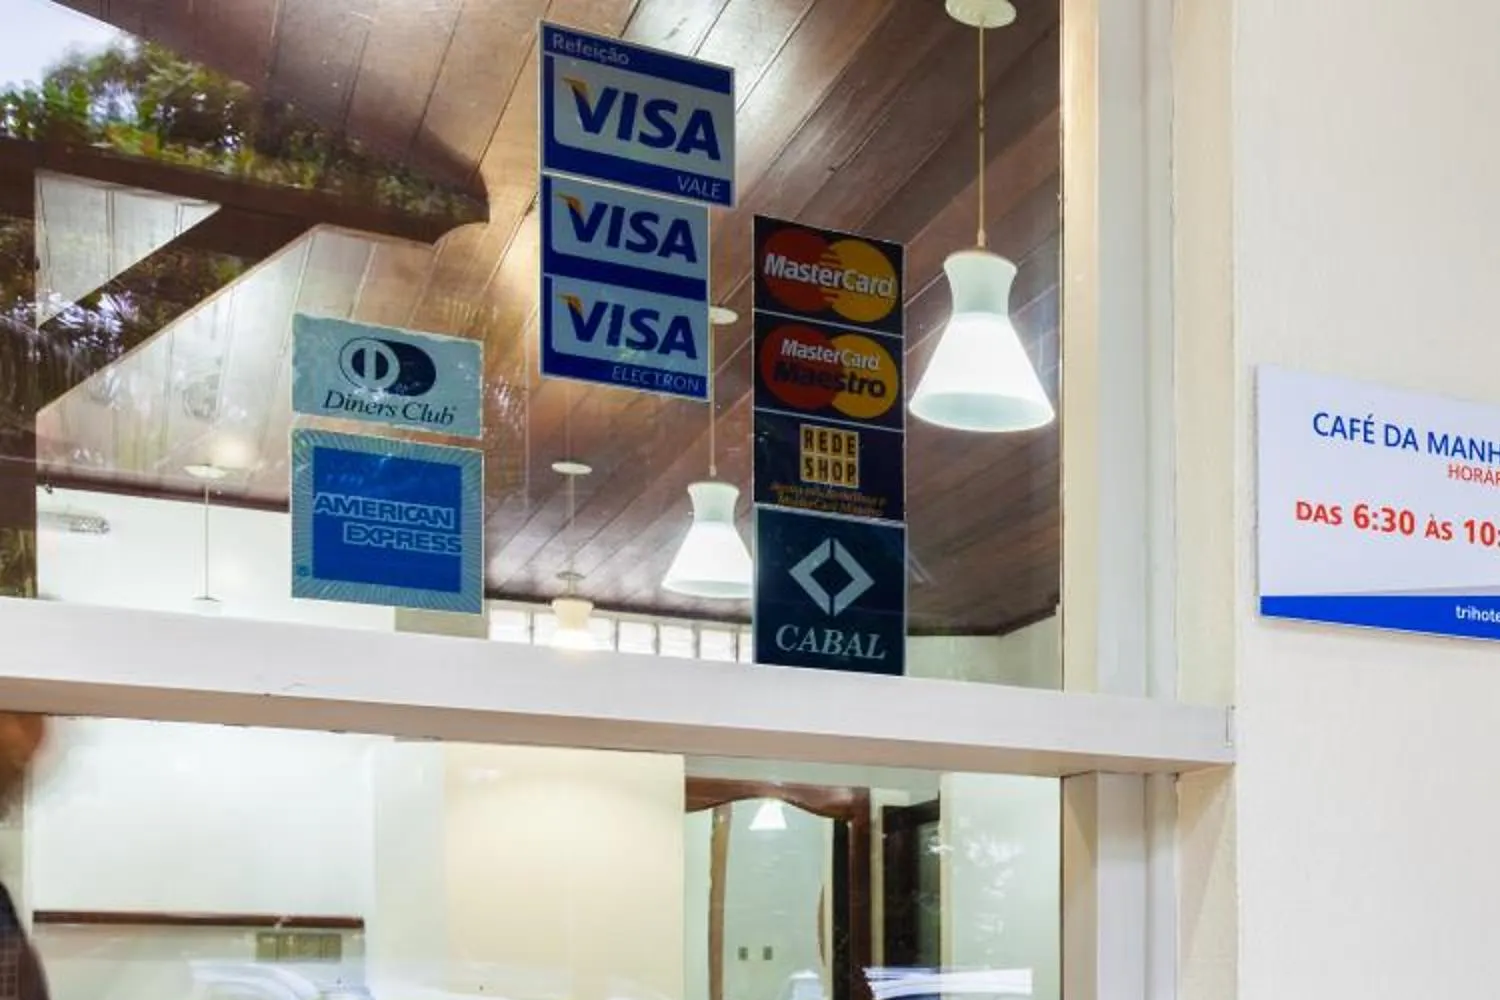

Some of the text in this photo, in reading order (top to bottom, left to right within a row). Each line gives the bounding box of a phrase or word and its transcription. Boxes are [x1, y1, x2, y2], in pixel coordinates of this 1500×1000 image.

[552, 33, 630, 65] Refeição
[562, 76, 721, 160] VISA
[677, 175, 721, 199] VALE
[556, 193, 697, 263] VISA
[764, 253, 893, 297] MasterCard
[557, 293, 697, 360] VISA
[780, 338, 881, 371] MasterCard
[611, 365, 700, 392] ELECTRON
[773, 358, 887, 398] Maestro
[322, 389, 398, 418] Diners
[804, 429, 857, 456] REDE
[1313, 412, 1375, 444] CAFÉ
[1384, 424, 1419, 452] DA
[804, 458, 857, 483] SHOP
[314, 492, 455, 529] AMERICAN
[1296, 501, 1342, 525] DAS
[1353, 503, 1415, 536] 6:30
[1425, 513, 1452, 541] ÀS
[343, 521, 463, 556] EXPRESS
[775, 623, 886, 660] CABAL
